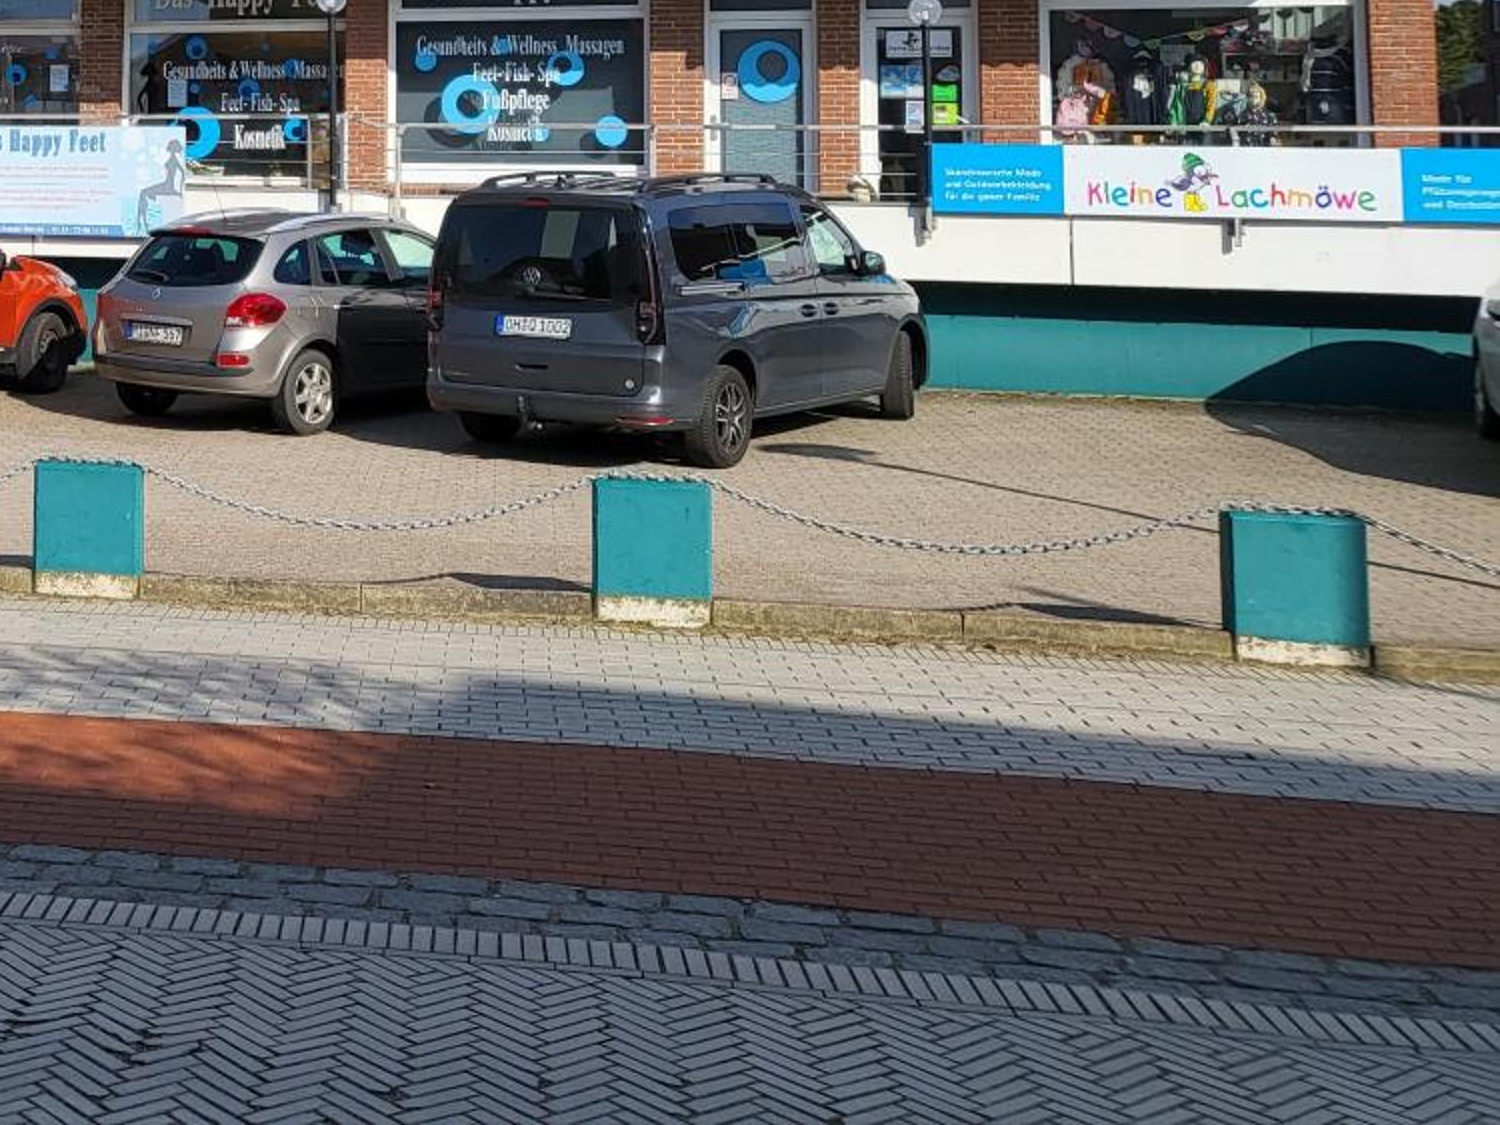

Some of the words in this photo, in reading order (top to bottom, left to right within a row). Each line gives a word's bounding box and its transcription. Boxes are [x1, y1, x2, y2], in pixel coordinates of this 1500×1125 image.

[417, 36, 487, 56] Gesundheits
[490, 36, 501, 55] &
[506, 35, 557, 55] Wellness
[565, 34, 625, 59] Massagen
[163, 61, 226, 79] Gesundheits
[229, 61, 239, 79] &
[240, 60, 285, 79] Wellness
[483, 89, 550, 115] Fußpflege
[9, 129, 62, 157] Happy
[69, 129, 106, 153] Feet
[234, 125, 286, 150] Kosmetik
[1087, 181, 1174, 208] Kleine
[1216, 182, 1377, 211] Lachmöwe
